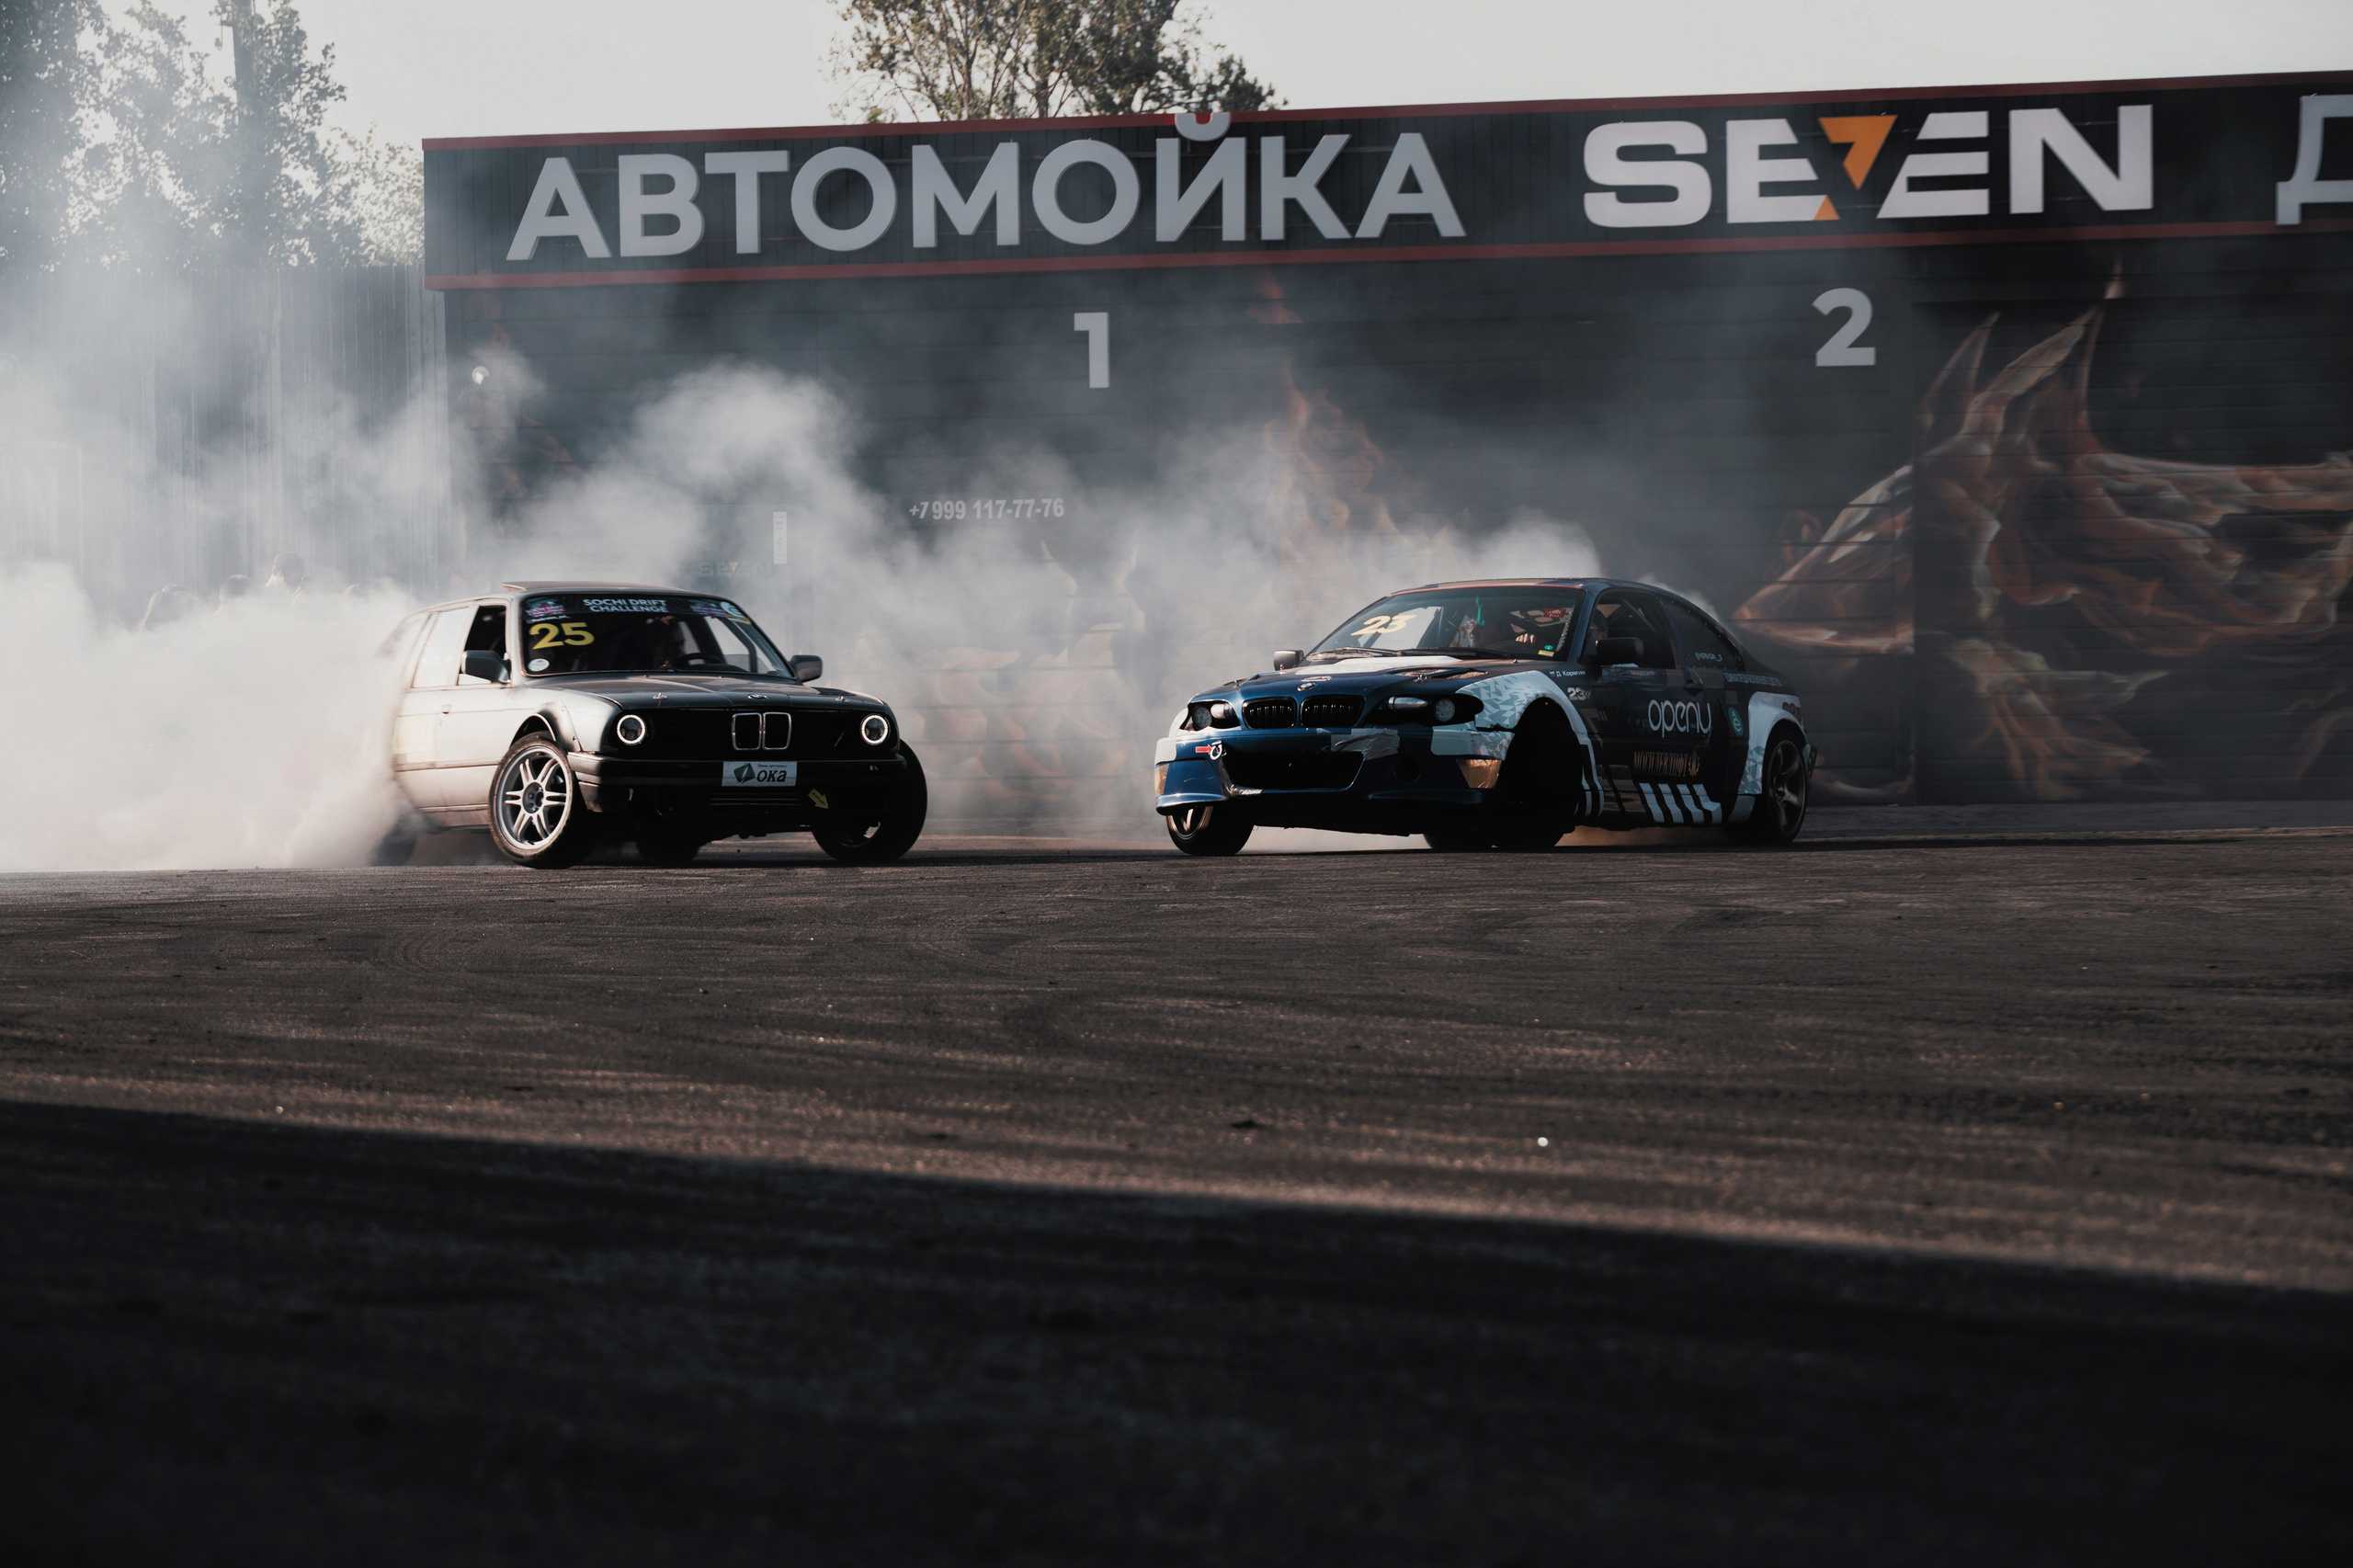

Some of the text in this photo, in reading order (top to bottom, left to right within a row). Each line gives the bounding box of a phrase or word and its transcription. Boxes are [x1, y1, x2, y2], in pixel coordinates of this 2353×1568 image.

[506, 112, 1466, 261] АВТОМОЙКА
[1812, 288, 1876, 367] 2
[1074, 312, 1109, 389] 1
[931, 500, 967, 520] 999
[972, 497, 1064, 519] 117-77-76
[629, 598, 666, 607] DRIFT
[529, 622, 595, 650] 25
[1350, 614, 1416, 636] 23
